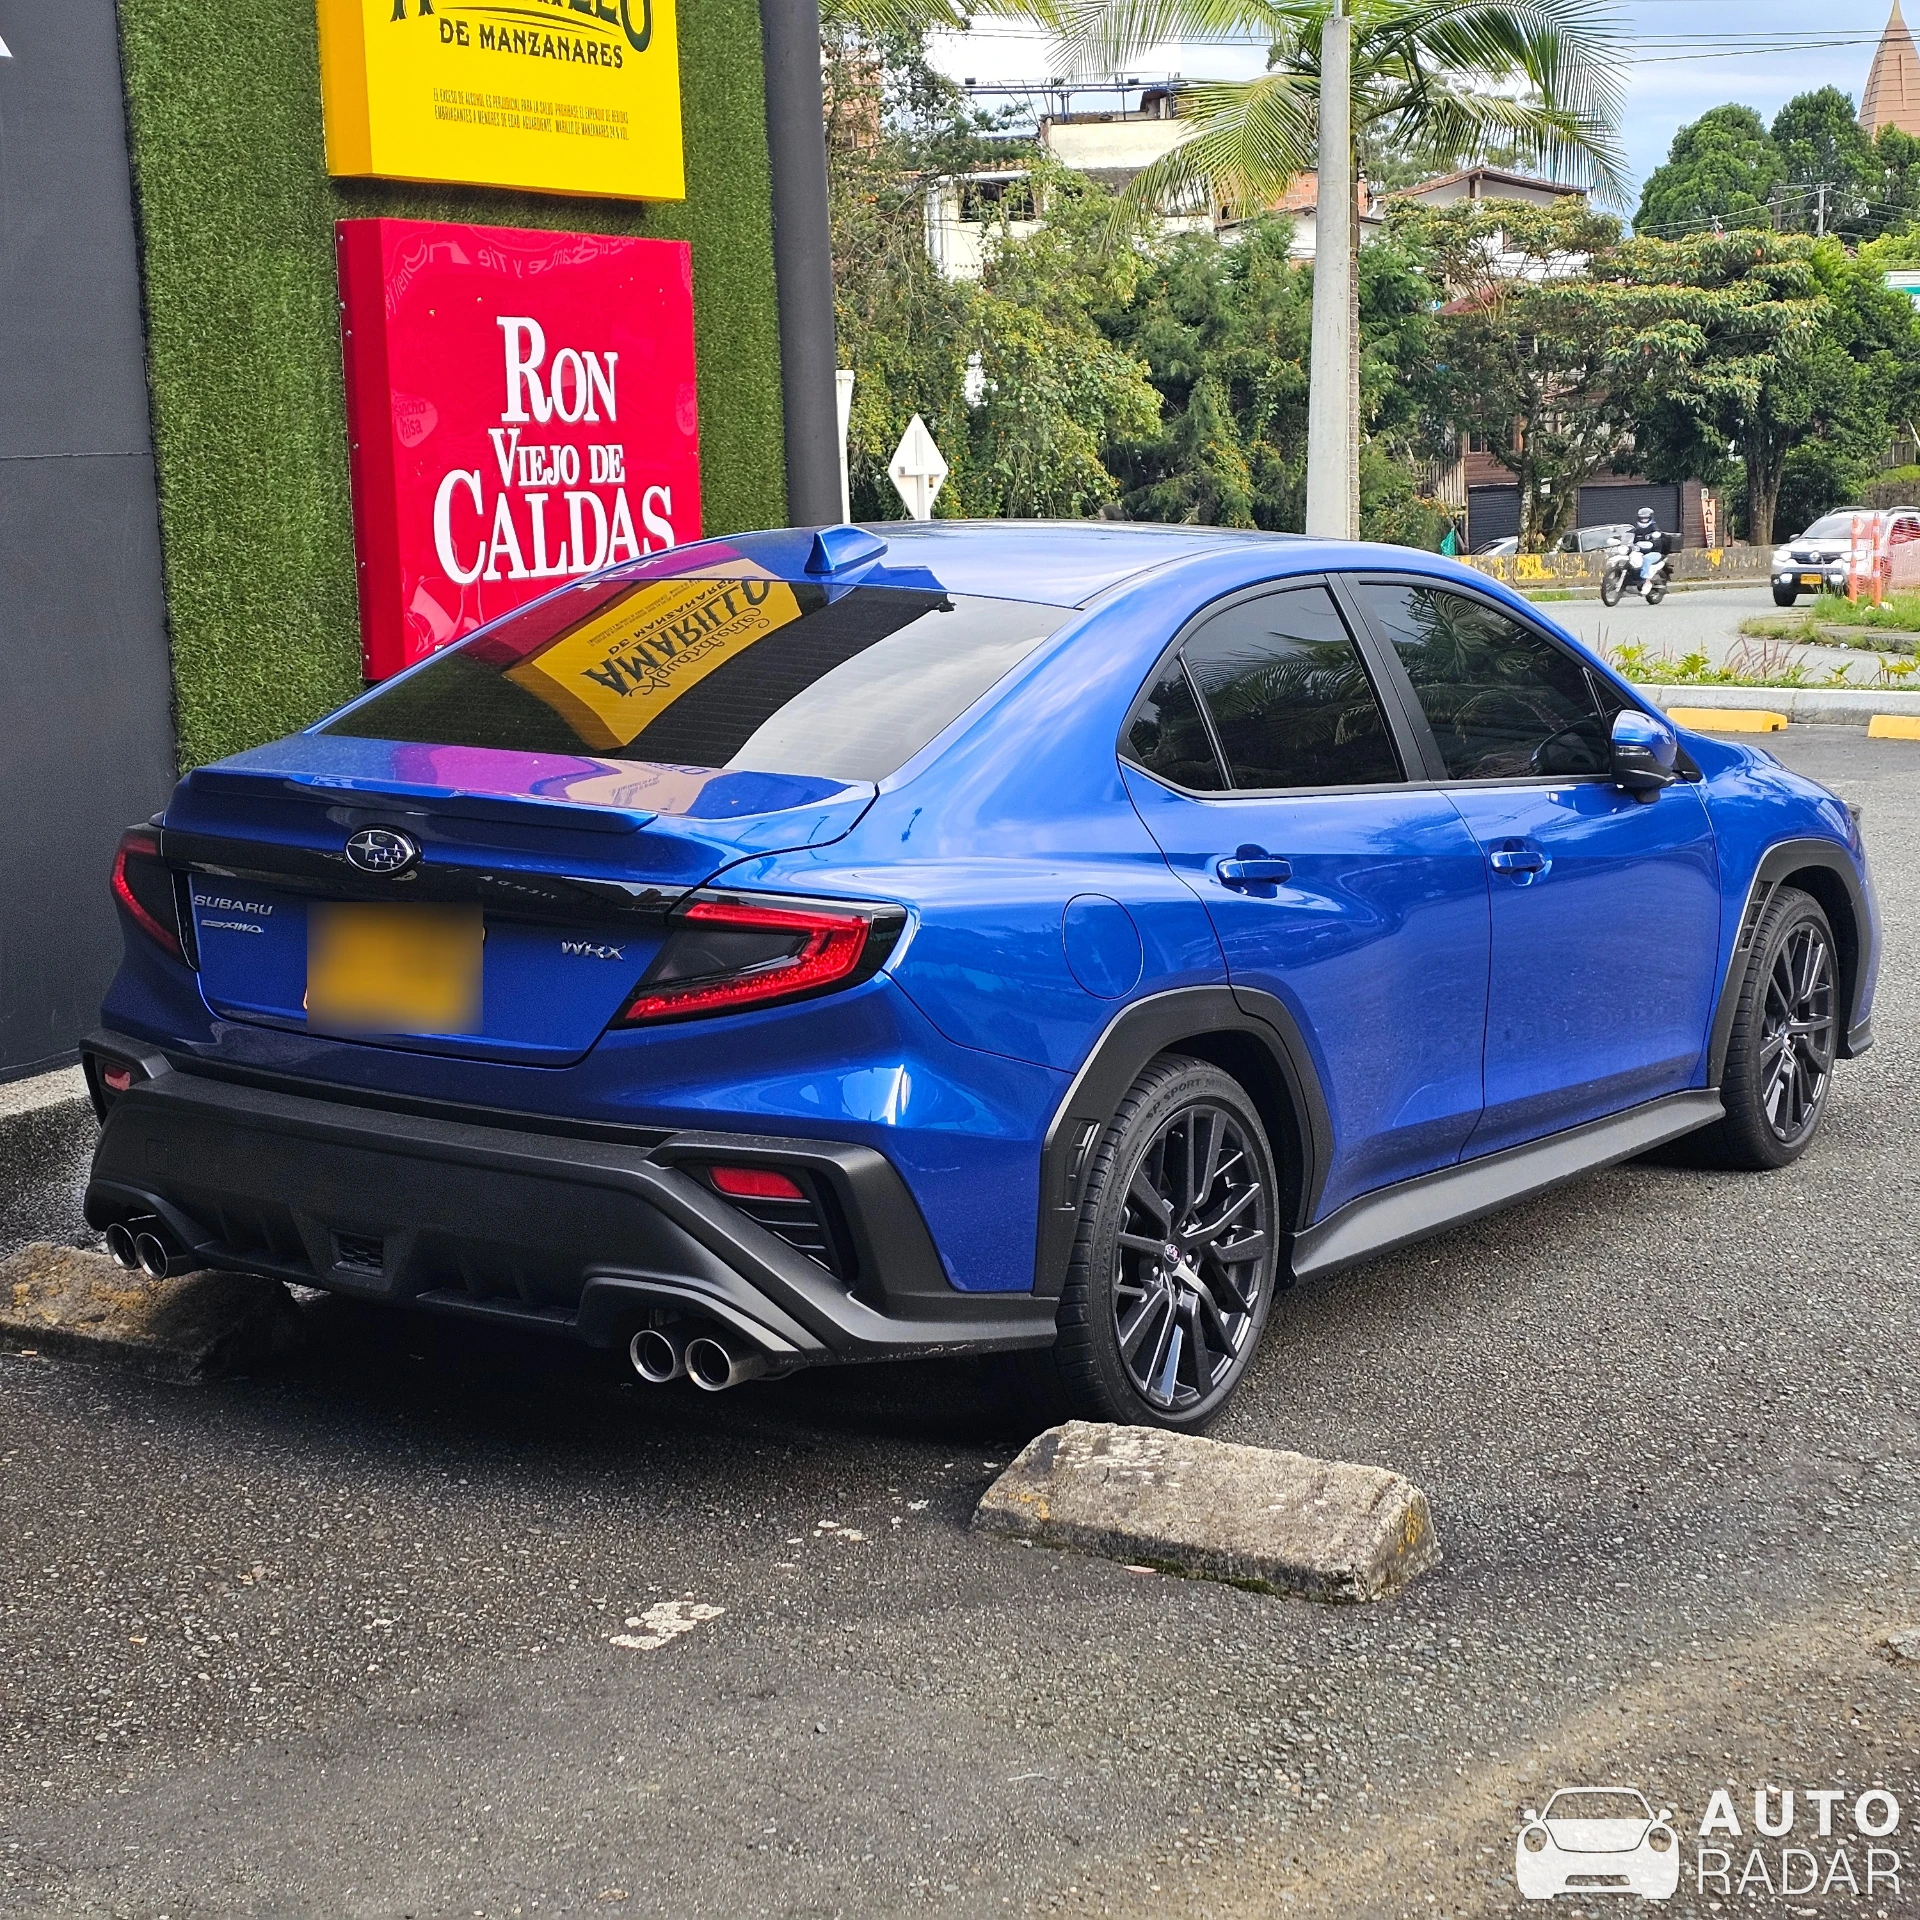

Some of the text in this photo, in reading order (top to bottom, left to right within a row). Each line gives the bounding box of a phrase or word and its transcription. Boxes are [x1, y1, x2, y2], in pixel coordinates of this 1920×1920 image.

[439, 17, 470, 47] DE
[479, 23, 624, 69] MANZANARES
[433, 87, 440, 102] EL
[439, 88, 458, 104] EXCESO
[457, 90, 465, 105] DE
[485, 93, 492, 108] ES
[521, 98, 533, 113] PARA
[434, 104, 473, 124] EMBRIAGANTES
[473, 109, 478, 124] A
[477, 110, 500, 127] MENORES
[496, 316, 620, 424] RON
[488, 428, 627, 487] VIEJO DE
[433, 469, 676, 585] CALDAS
[194, 894, 274, 916] SUBARU
[561, 940, 627, 961] WRX
[1145, 1101, 1161, 1120] SP
[1163, 1078, 1202, 1101] SPORT
